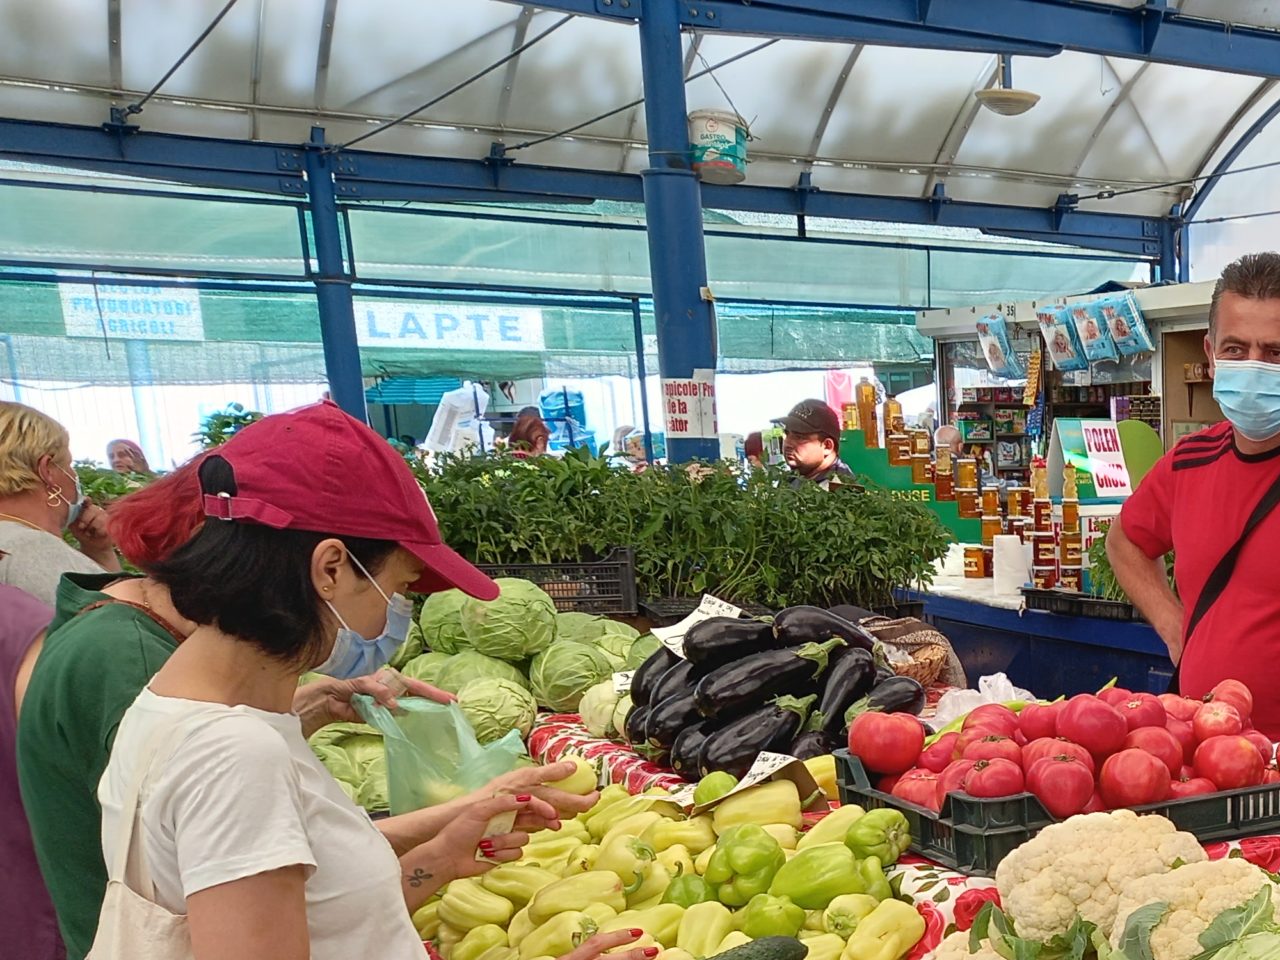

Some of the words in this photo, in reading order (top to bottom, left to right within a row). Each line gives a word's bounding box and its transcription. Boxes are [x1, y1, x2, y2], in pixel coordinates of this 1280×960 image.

[1006, 304, 1015, 317] 35
[366, 309, 523, 342] LAPTE
[1084, 427, 1120, 454] POLEN
